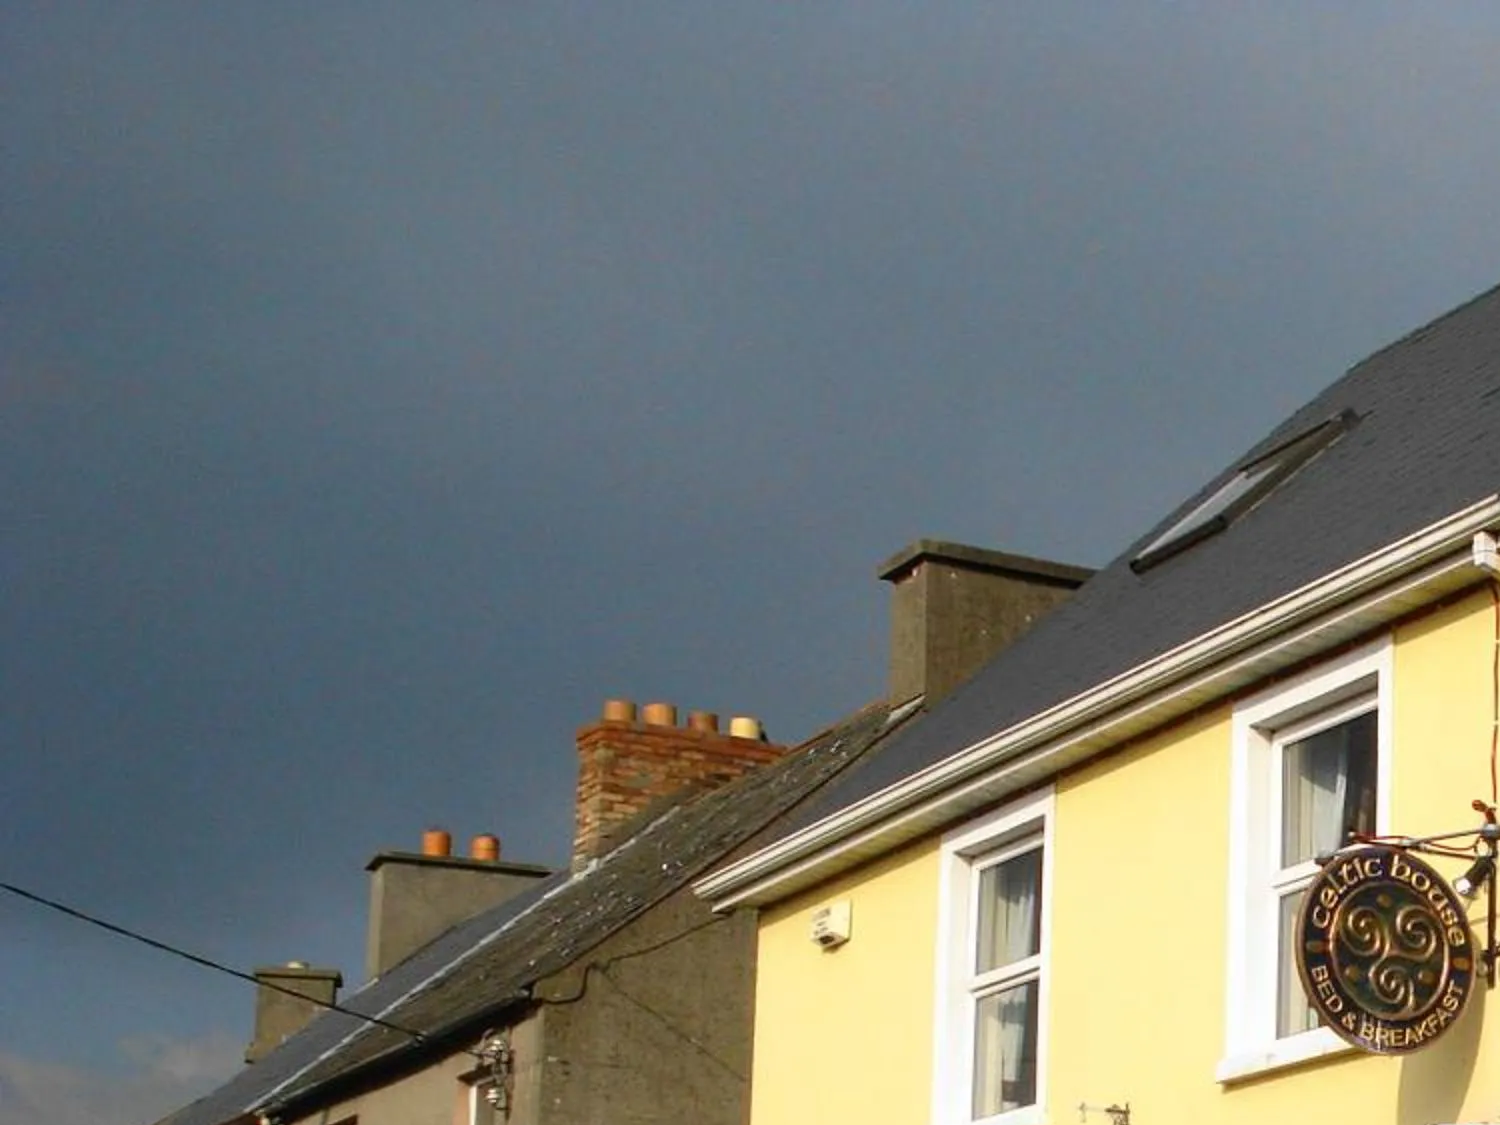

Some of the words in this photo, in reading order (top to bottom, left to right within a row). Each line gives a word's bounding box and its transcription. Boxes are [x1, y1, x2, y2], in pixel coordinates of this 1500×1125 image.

[1311, 964, 1343, 1013] BED
[1341, 1011, 1357, 1030] &
[1360, 979, 1463, 1047] BREAKFAST
